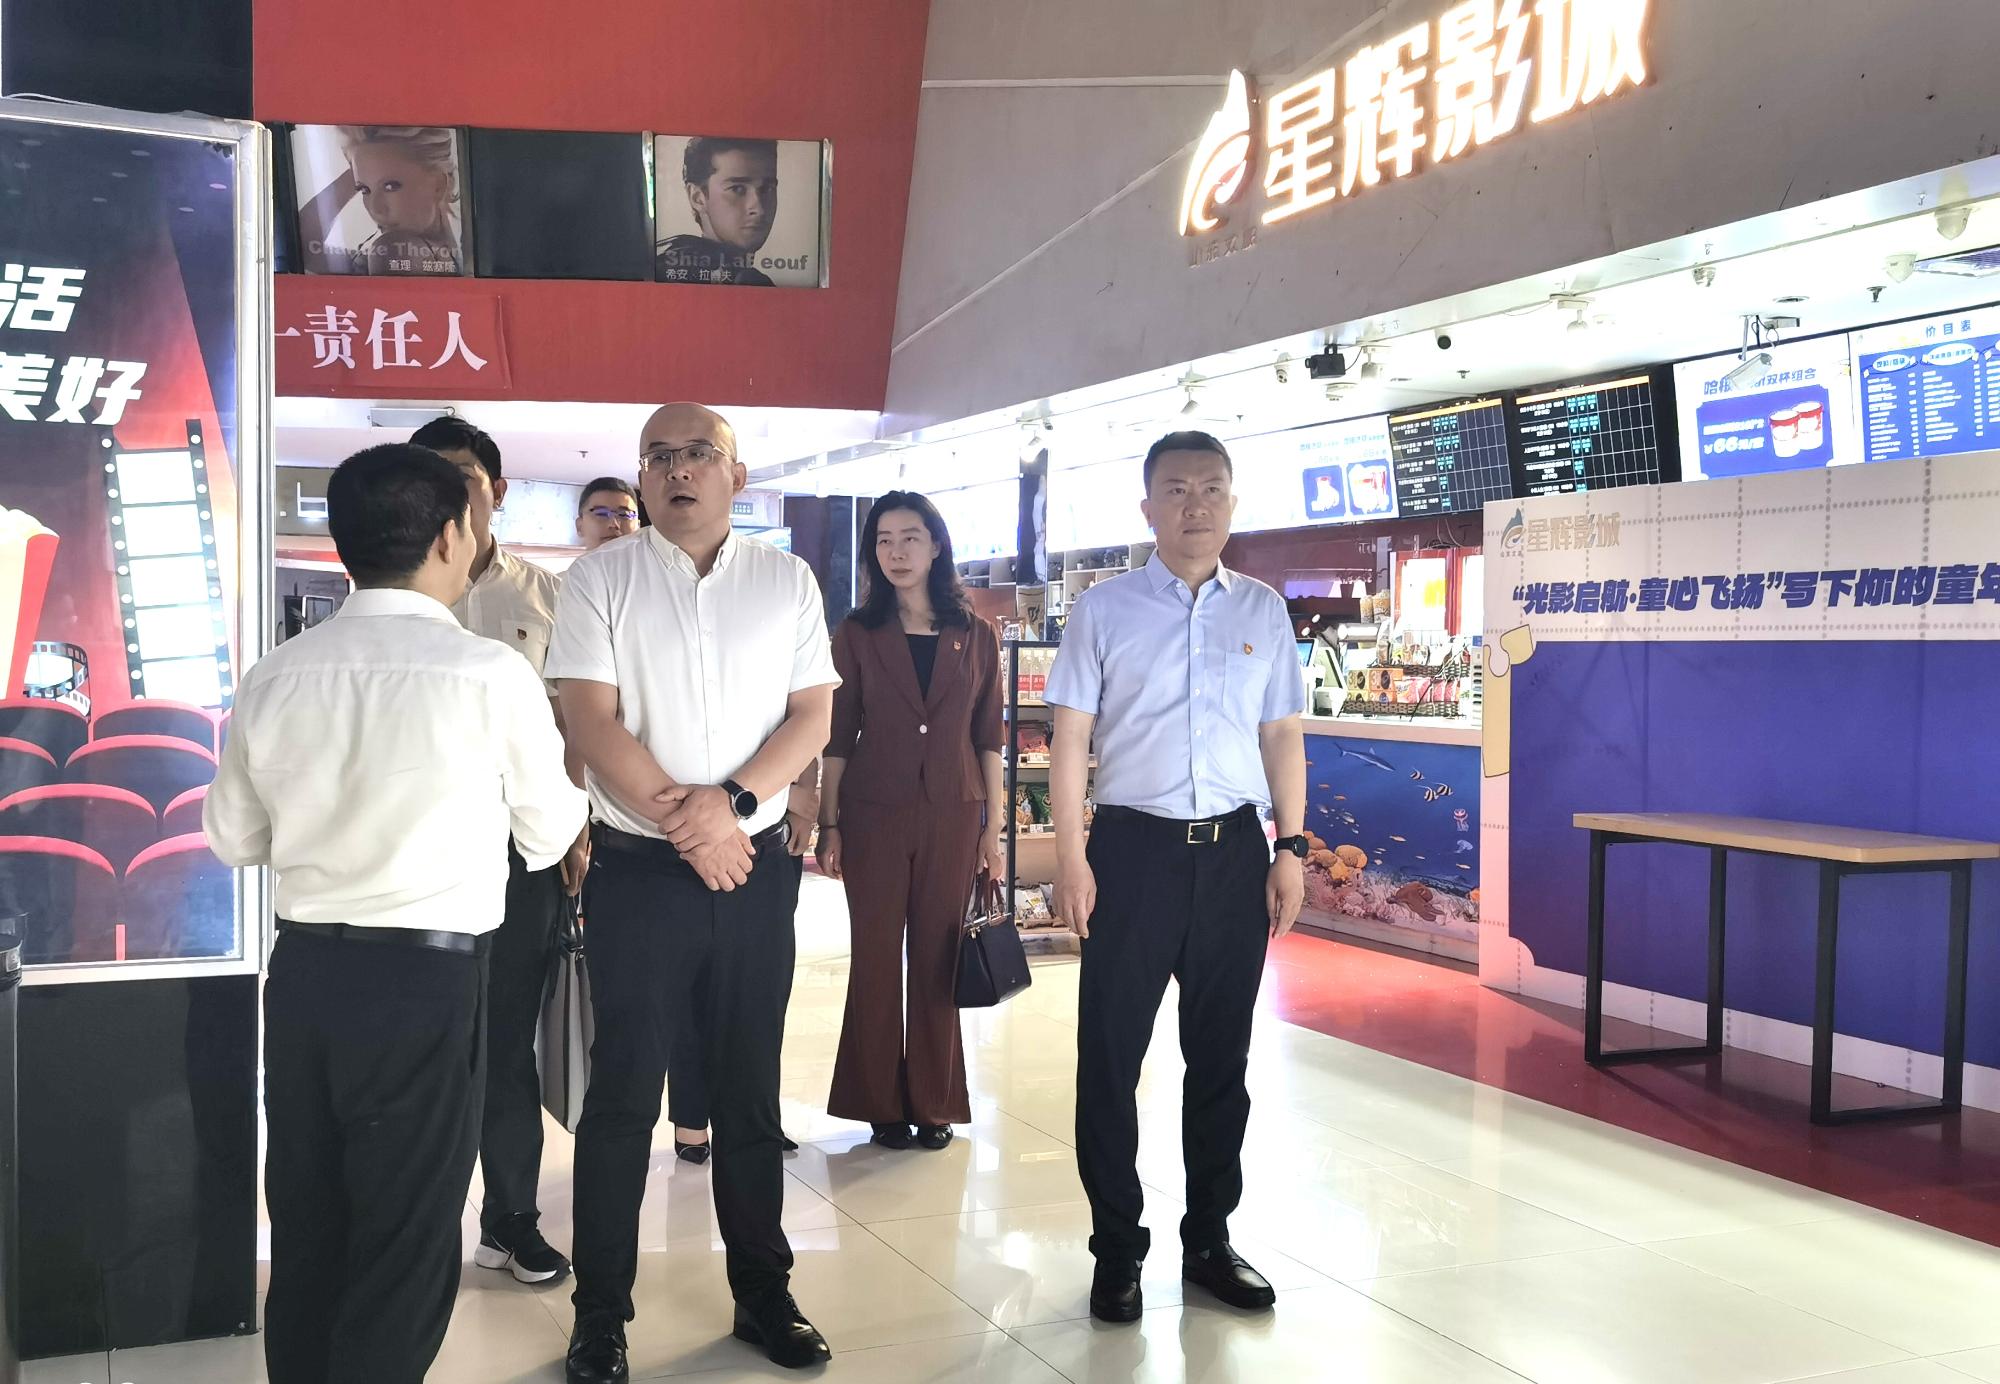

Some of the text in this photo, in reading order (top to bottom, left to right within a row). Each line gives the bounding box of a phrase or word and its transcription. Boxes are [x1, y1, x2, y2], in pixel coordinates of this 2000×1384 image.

[1262, 0, 1647, 225] 星辉影城
[0, 263, 87, 333] 活
[1925, 319, 1972, 338] 价目表
[0, 352, 148, 426] 美好
[1526, 511, 1621, 552] 星辉影城
